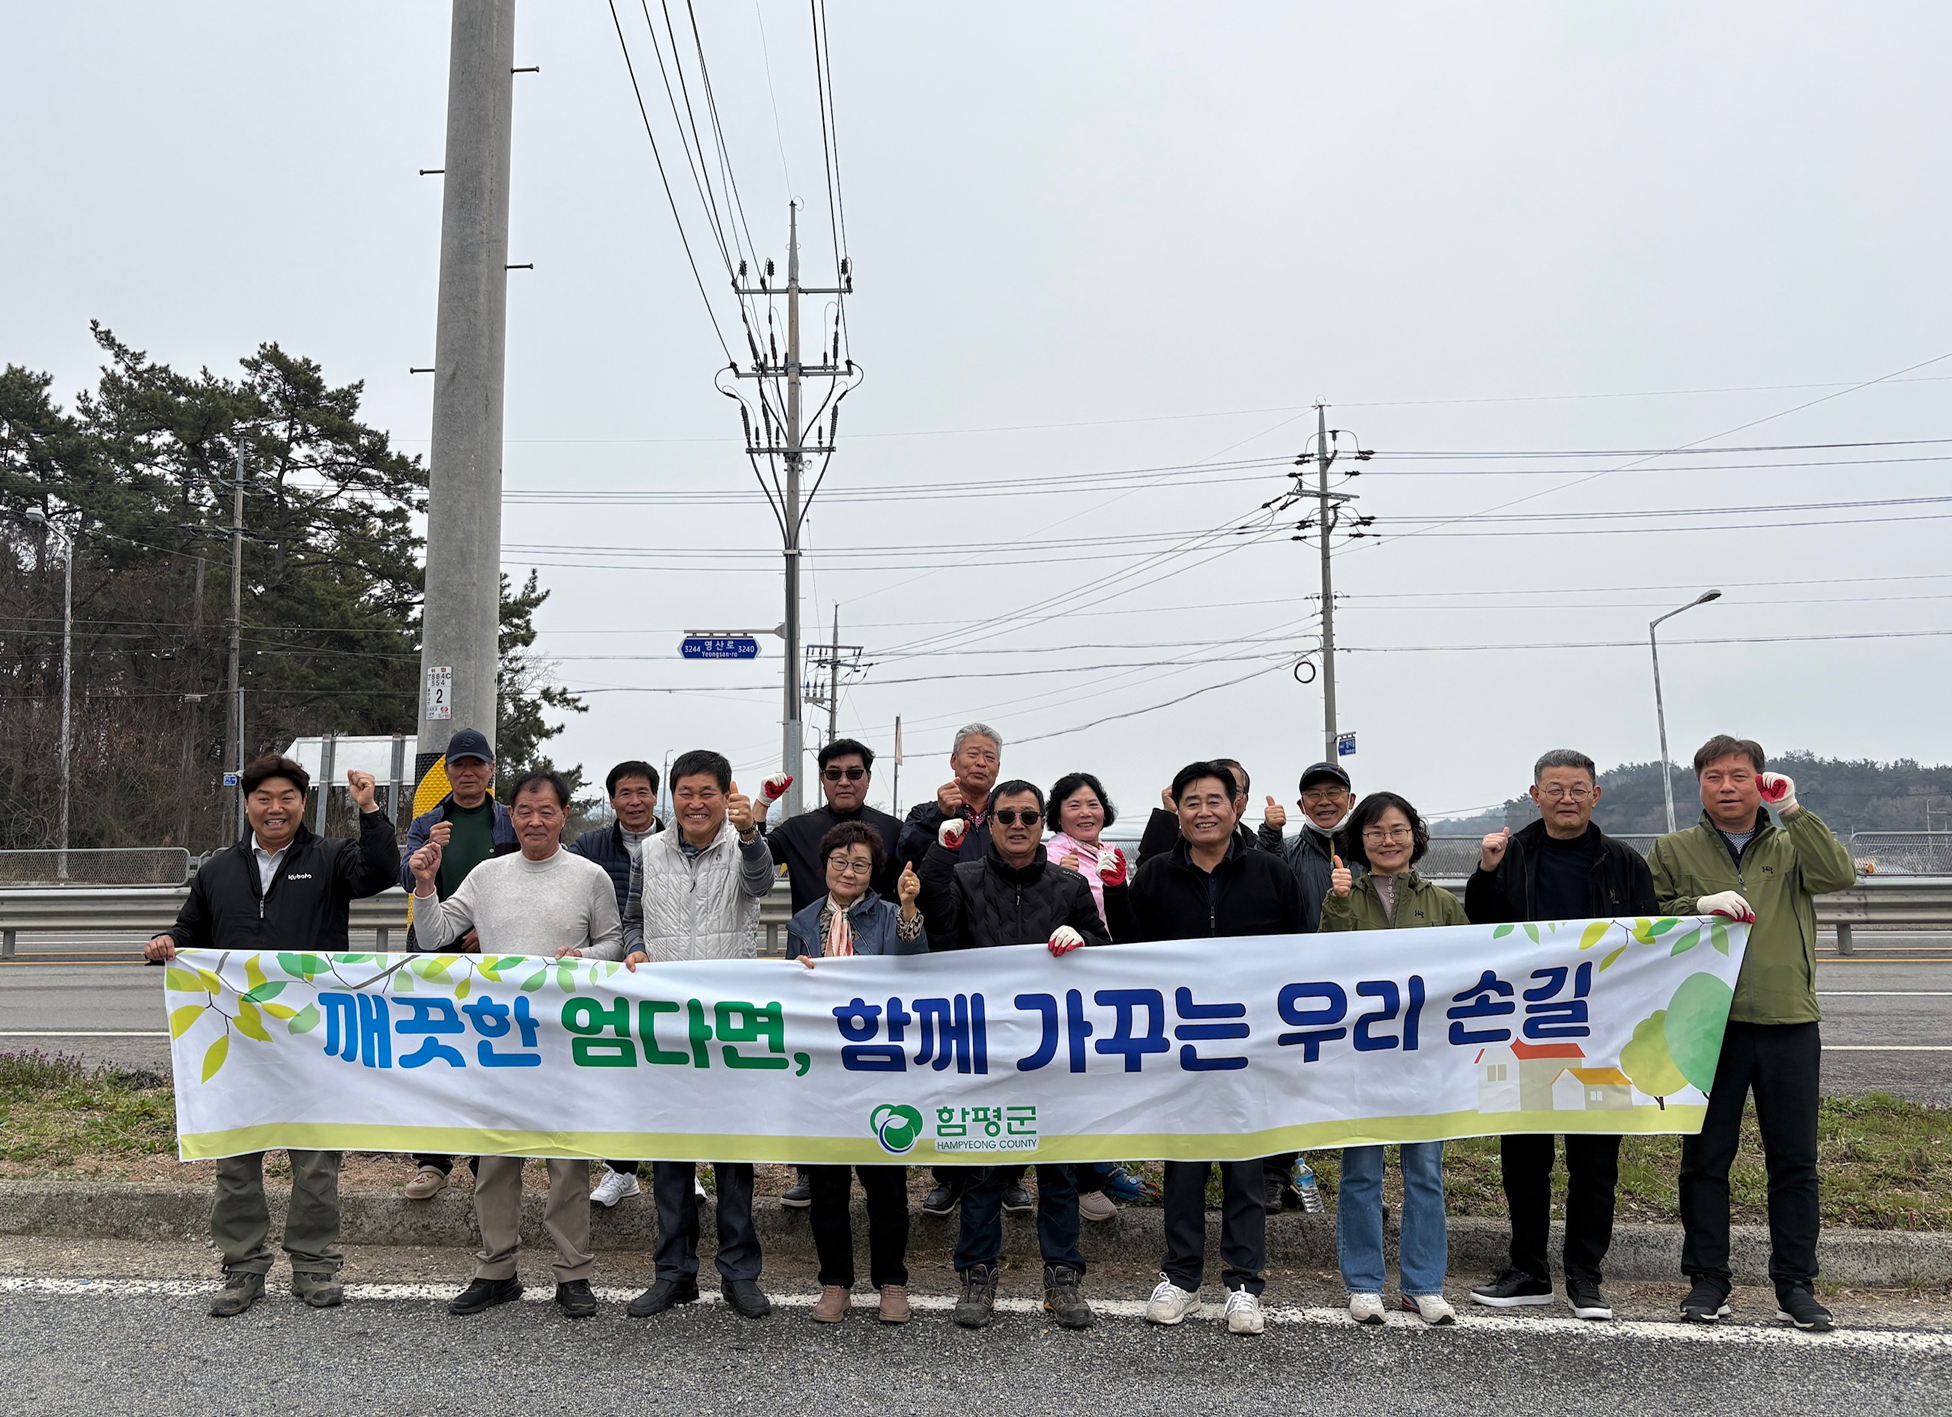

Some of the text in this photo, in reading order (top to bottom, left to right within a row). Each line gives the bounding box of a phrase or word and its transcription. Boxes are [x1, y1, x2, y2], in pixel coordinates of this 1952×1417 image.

[684, 640, 755, 653] 3244 영산로 3240
[436, 688, 443, 704] 2
[318, 961, 1593, 1077] 깨끗한 엄다면, 함께 가꾸는 우리 손길
[936, 1106, 1037, 1137] 함평군
[937, 1139, 1037, 1150] HAMPYEONG COUNTY
